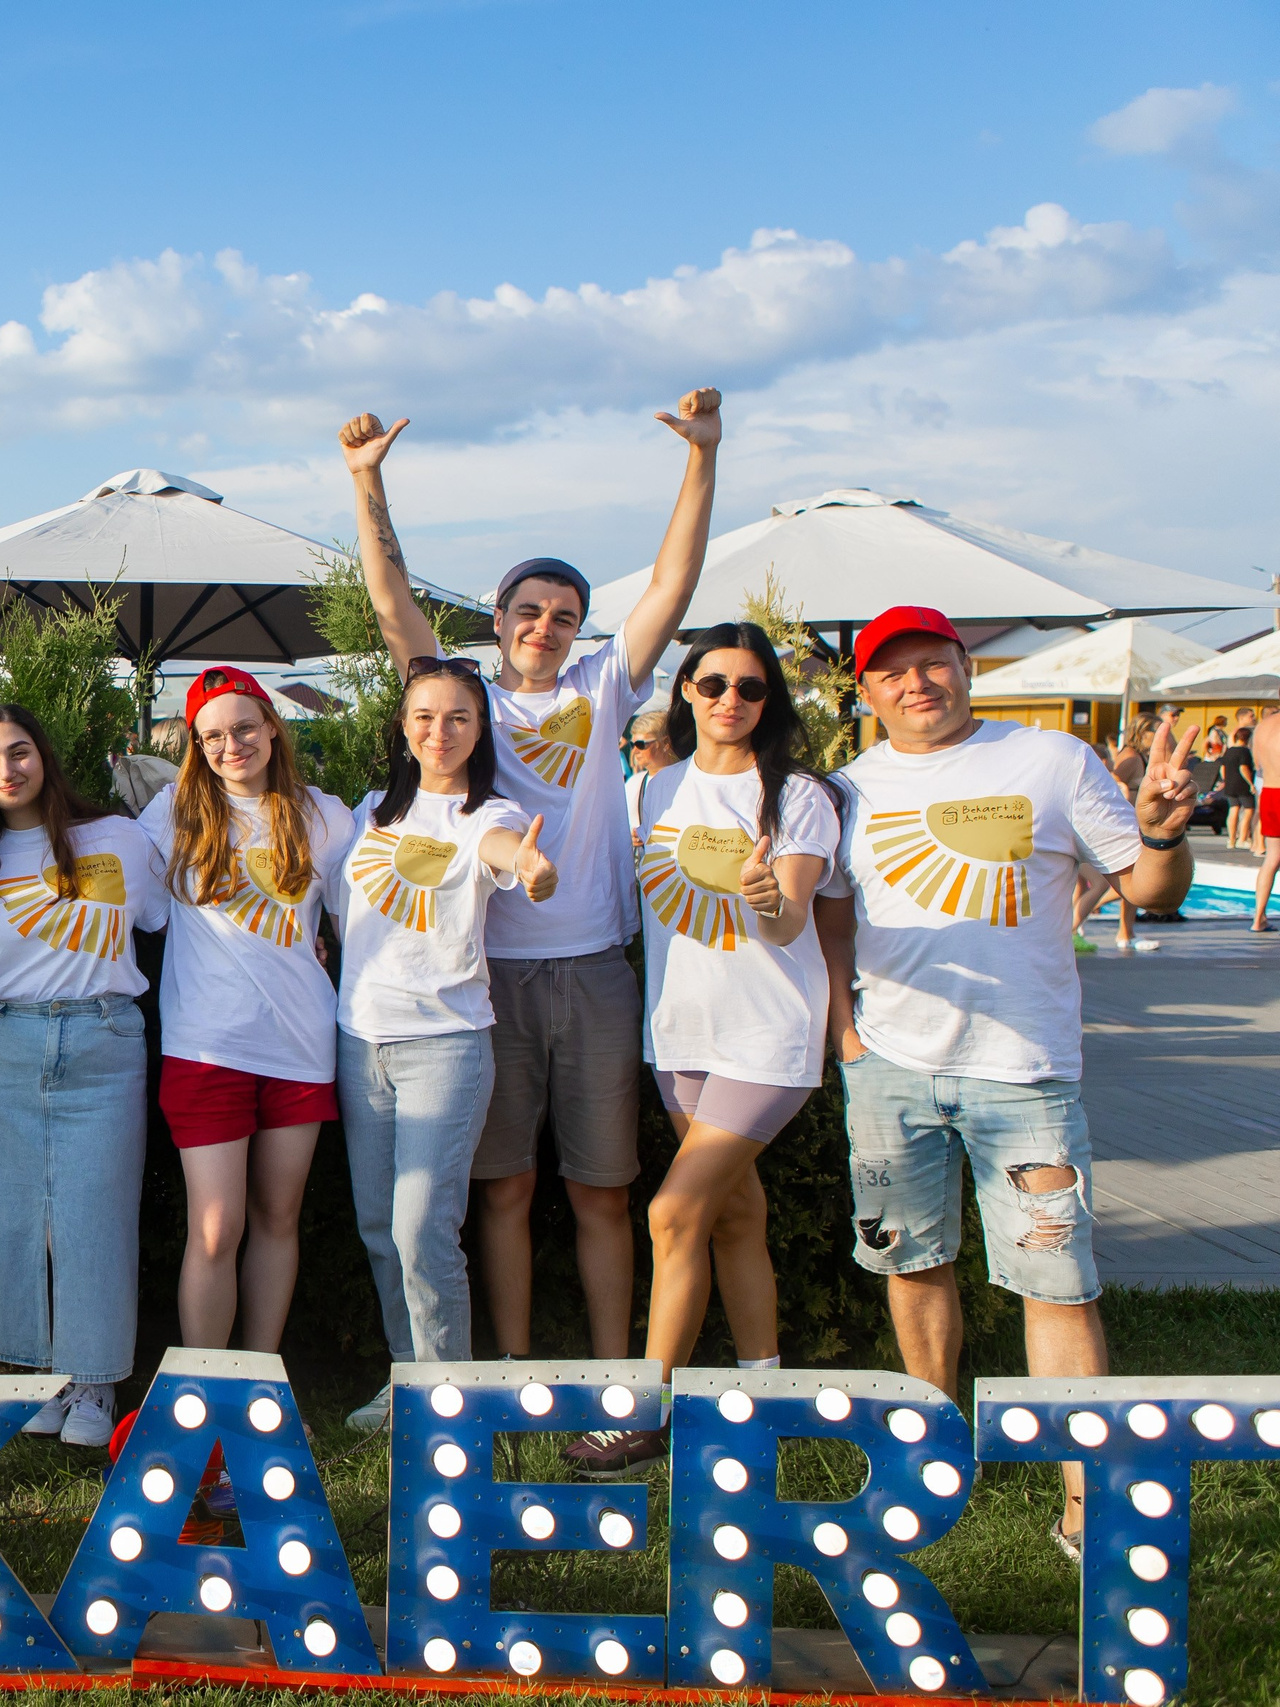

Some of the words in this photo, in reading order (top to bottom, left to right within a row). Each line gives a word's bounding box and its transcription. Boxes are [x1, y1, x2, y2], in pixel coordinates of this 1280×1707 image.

[962, 803, 1009, 815] Bekaert
[962, 814, 988, 823] День
[991, 812, 1025, 820] Семьи
[866, 1169, 891, 1187] 36
